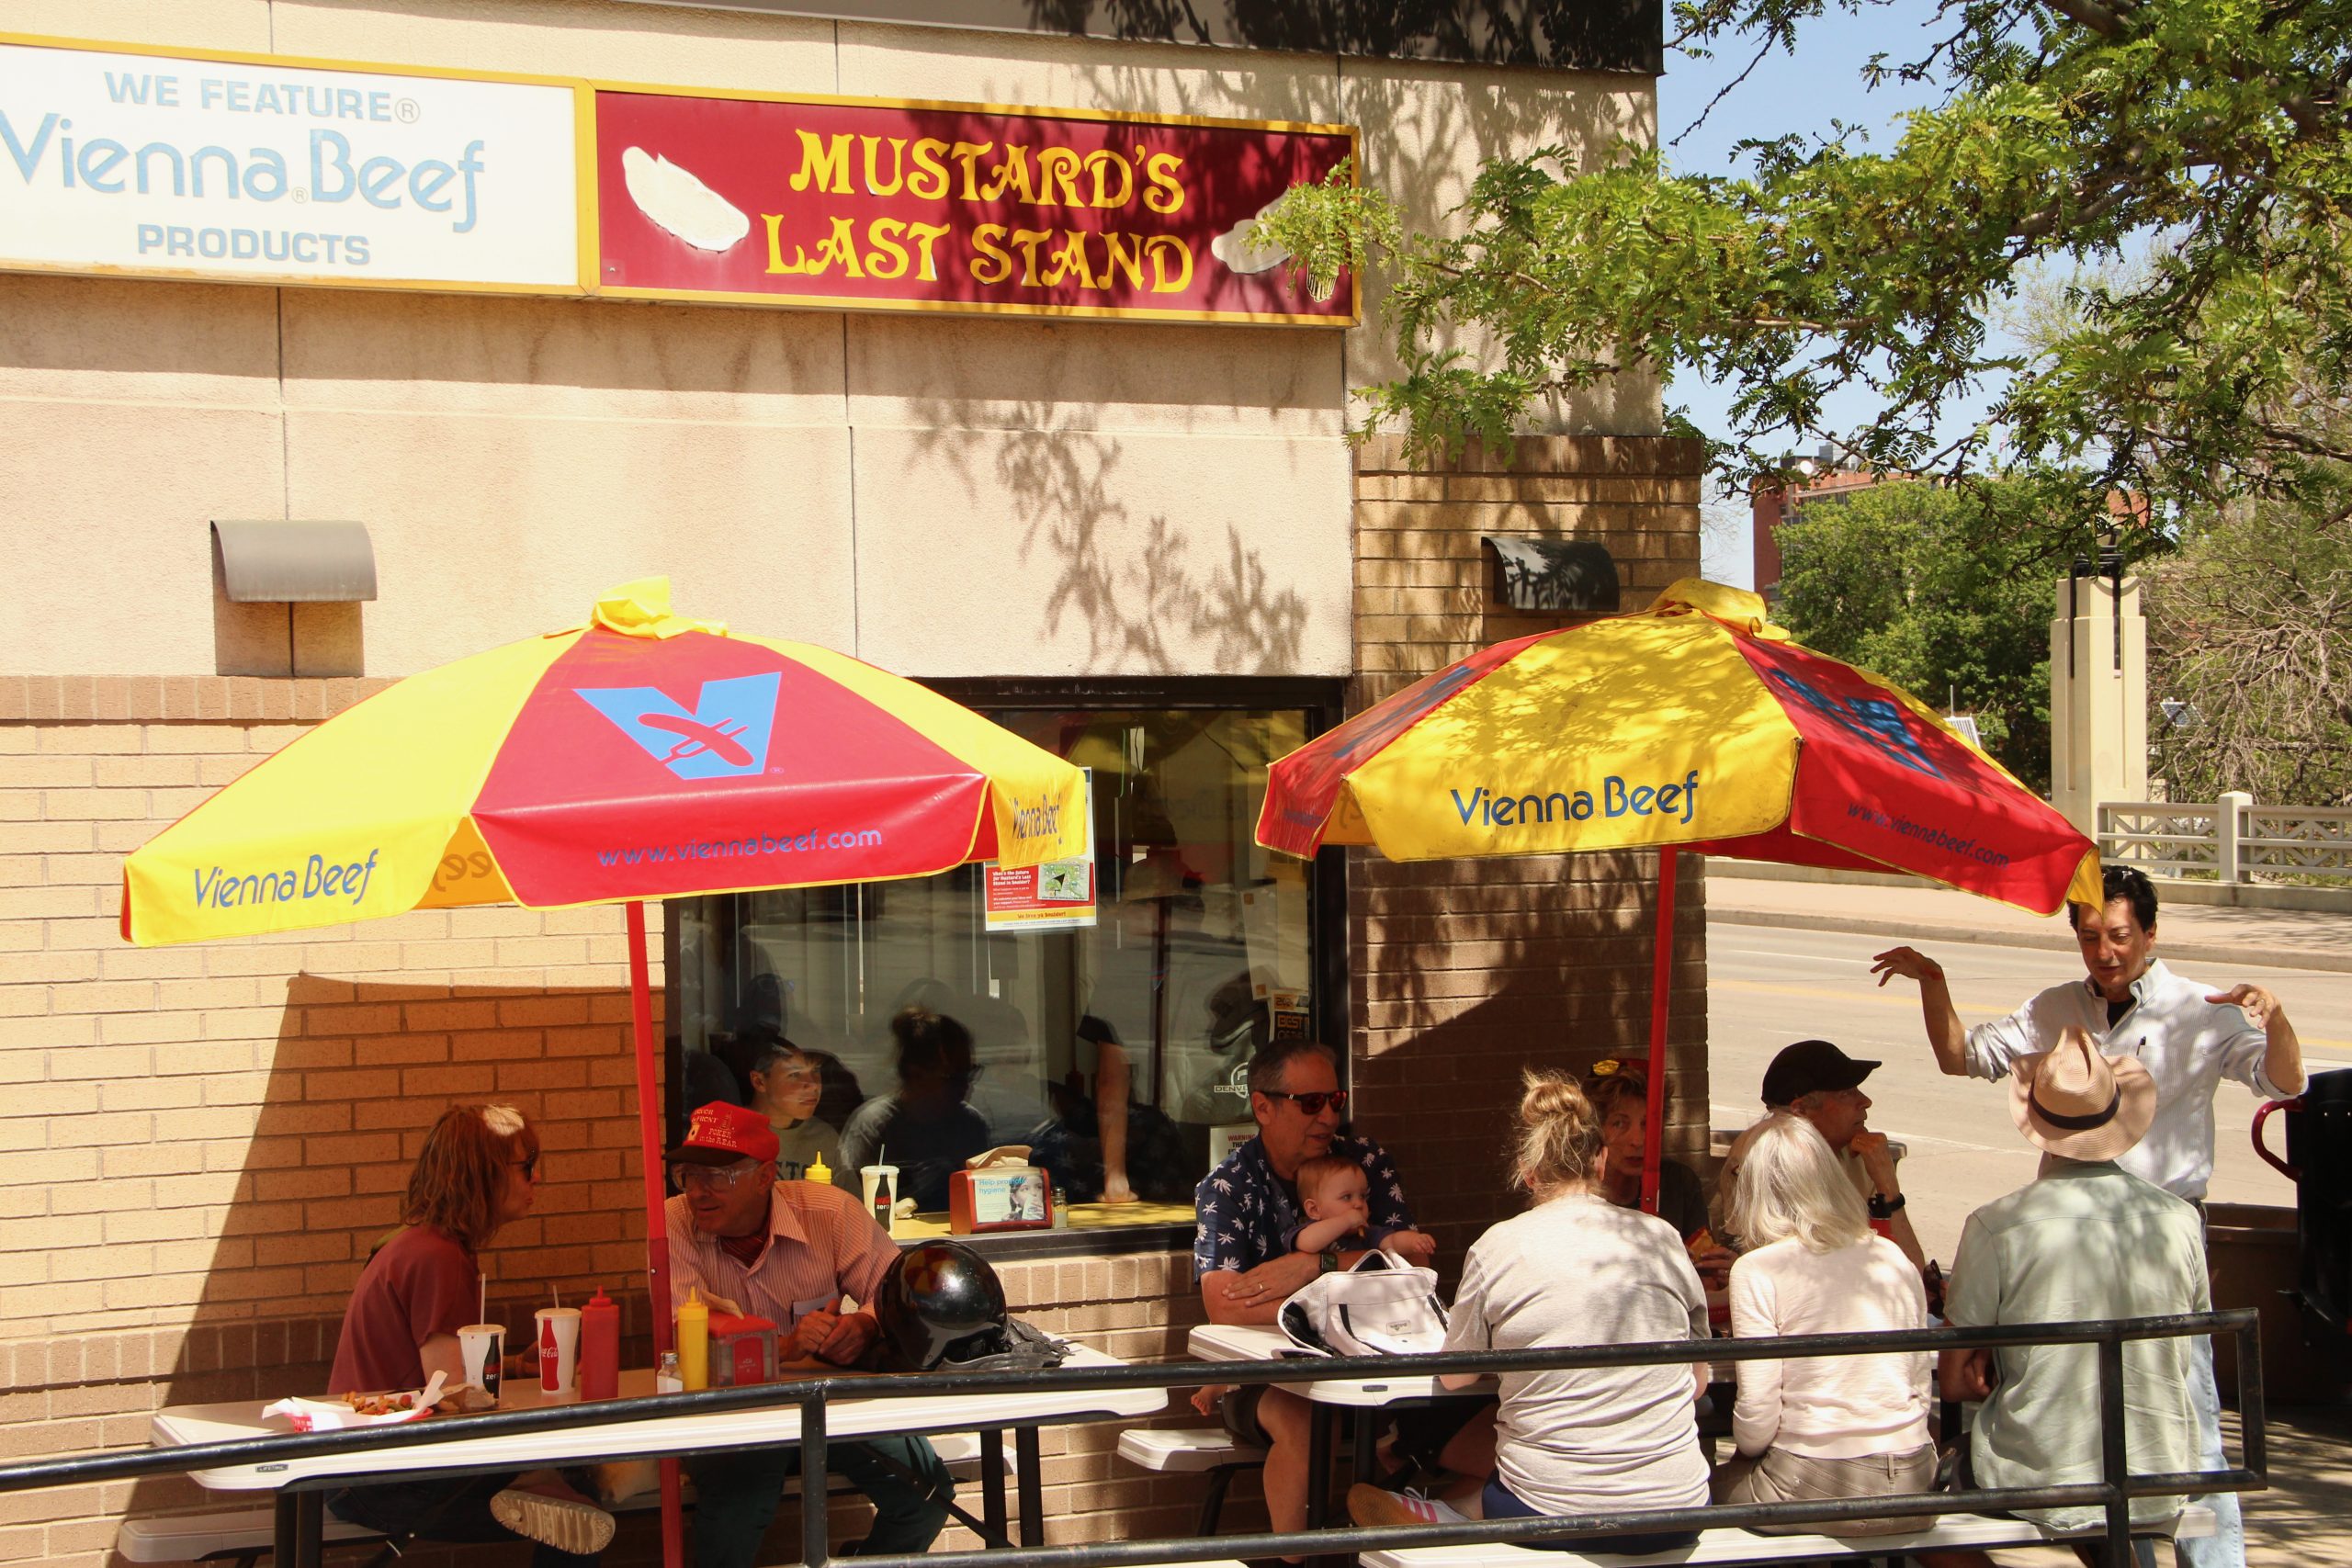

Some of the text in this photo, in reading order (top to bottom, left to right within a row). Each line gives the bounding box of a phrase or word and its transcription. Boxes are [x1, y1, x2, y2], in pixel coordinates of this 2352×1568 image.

[104, 71, 179, 107] WE
[0, 109, 485, 233] Vienna Beef
[788, 128, 1186, 214] MUSTARD'S
[137, 223, 372, 265] PRODUCTS
[761, 213, 1194, 294] LAST STAND
[1450, 770, 1699, 827] Vienna Beef
[597, 828, 882, 866] www.viennabeef.com
[1847, 802, 2010, 869] www.viennabeef.com
[194, 848, 379, 909] Vienna Beef
[708, 1128, 731, 1139] POKER
